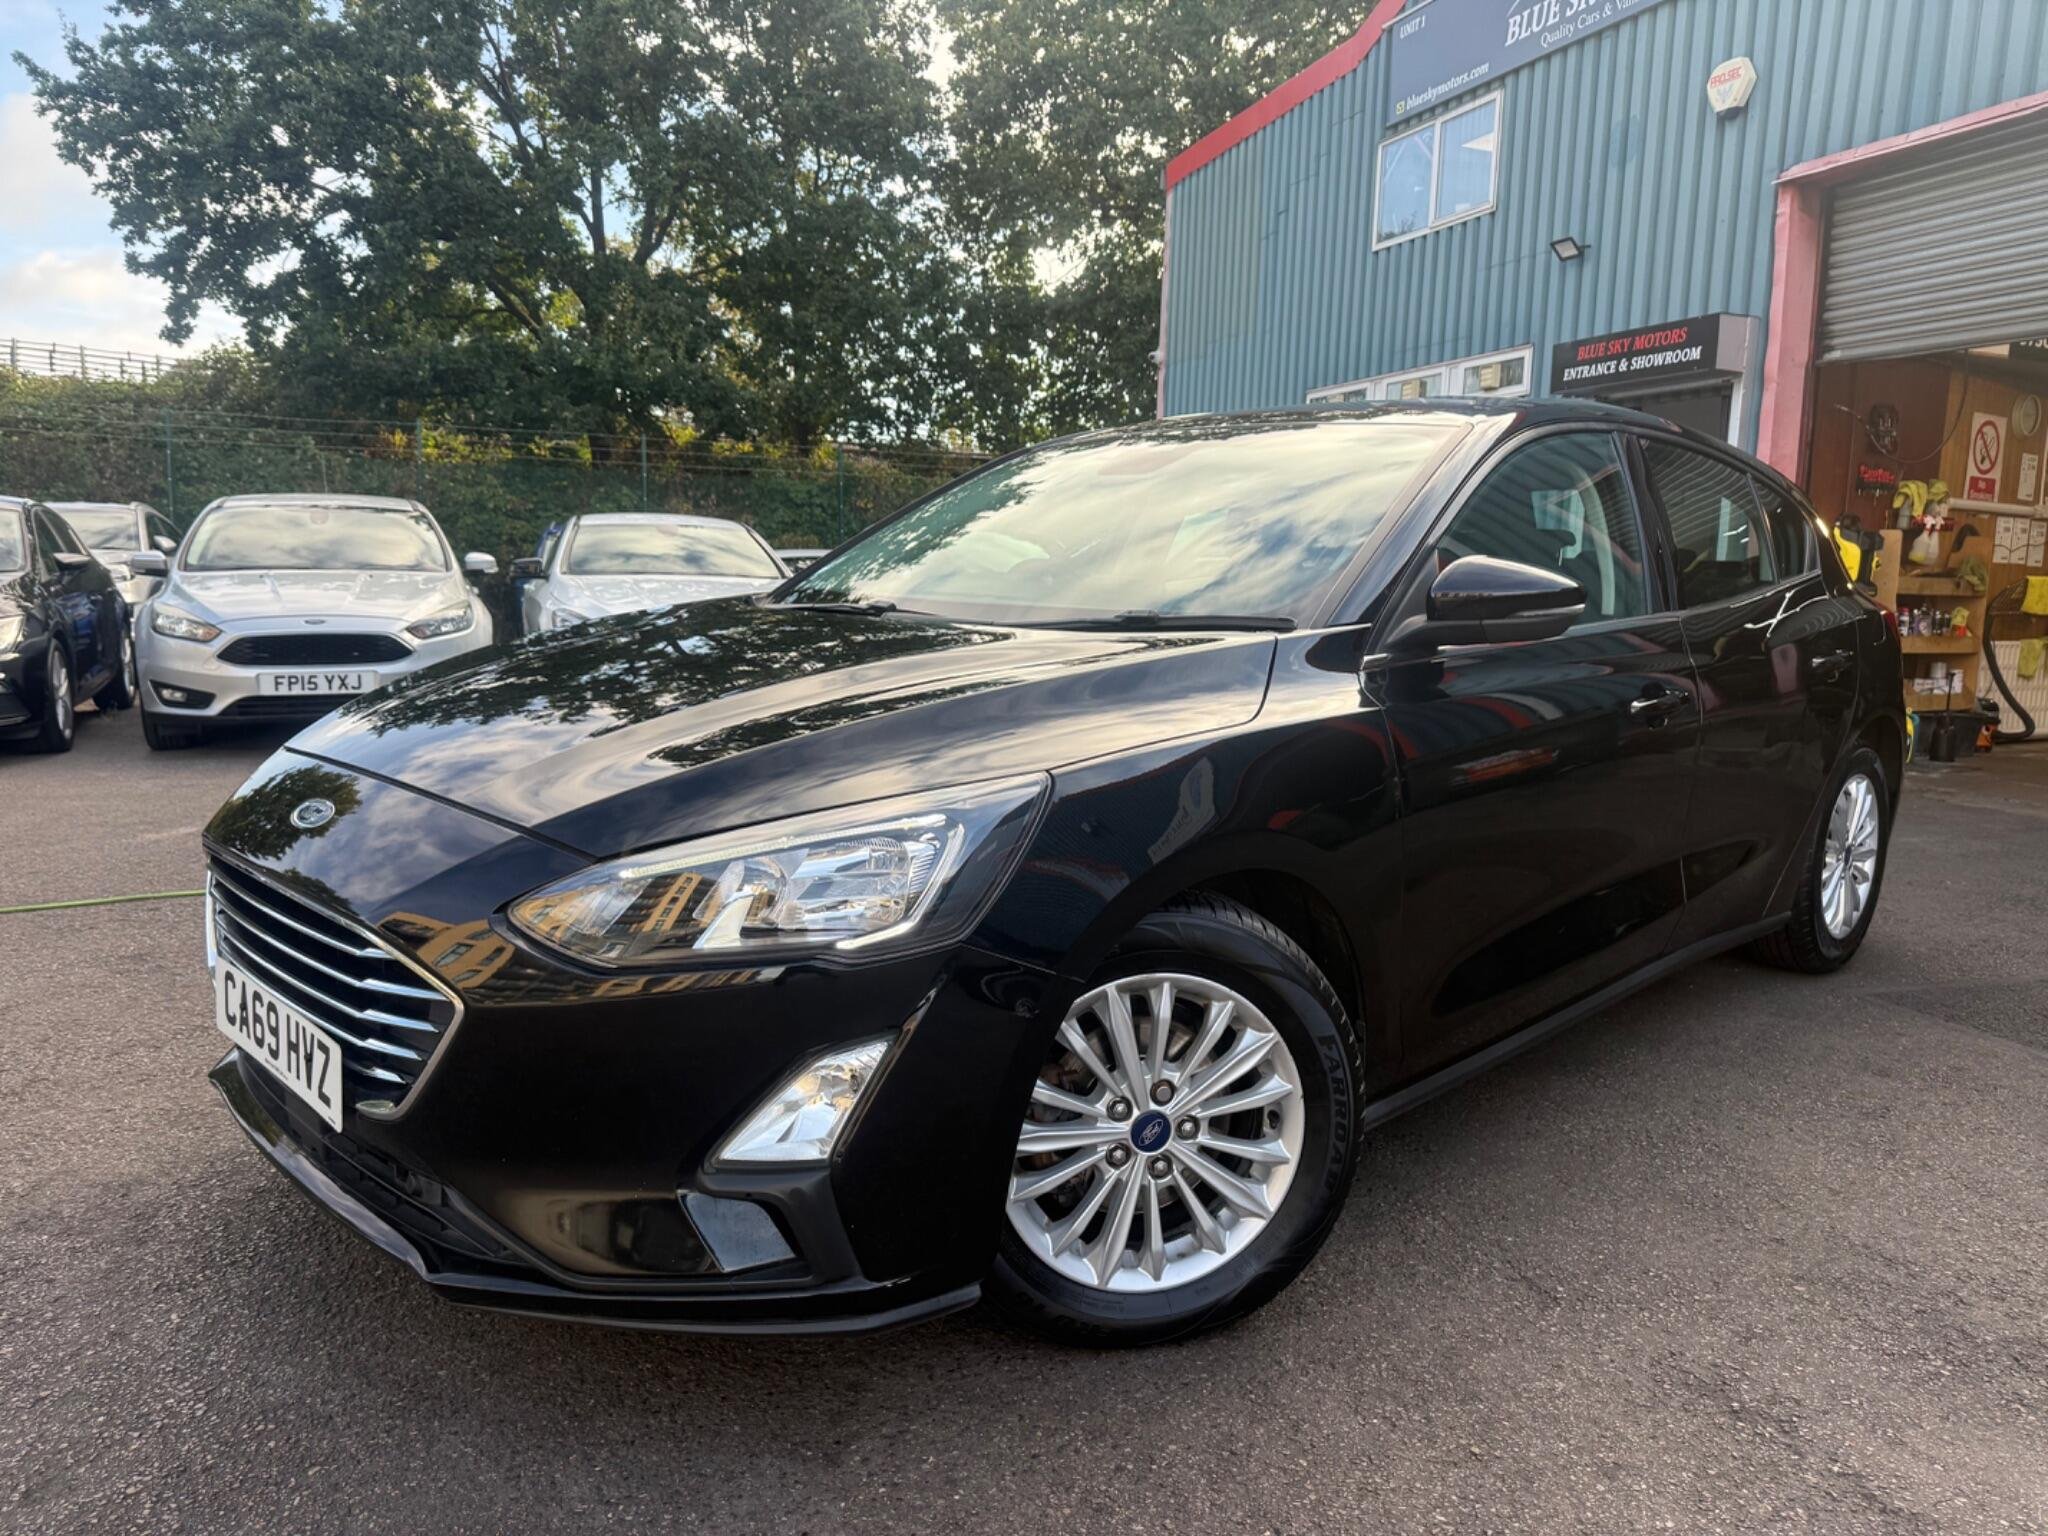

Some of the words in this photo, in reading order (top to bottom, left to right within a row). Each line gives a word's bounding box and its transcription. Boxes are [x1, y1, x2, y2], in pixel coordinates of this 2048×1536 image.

[1505, 0, 1560, 47] BLUE
[1541, 22, 1575, 48] Quality
[1577, 10, 1600, 28] Cars
[1602, 2, 1613, 18] &
[1615, 0, 1638, 10] Van
[1406, 62, 1490, 110] blueskymotors.com
[1563, 361, 1617, 381] ENTRANCE
[1618, 358, 1629, 372] &
[1630, 346, 1702, 370] SHOWROOM
[1577, 341, 1606, 360] BLUE
[1608, 338, 1631, 355] SKY
[1632, 327, 1688, 351] MOTORS
[274, 675, 318, 691] FP15
[324, 674, 362, 691] YXJ
[225, 970, 280, 1062] CA69
[286, 1013, 331, 1109] HVZ
